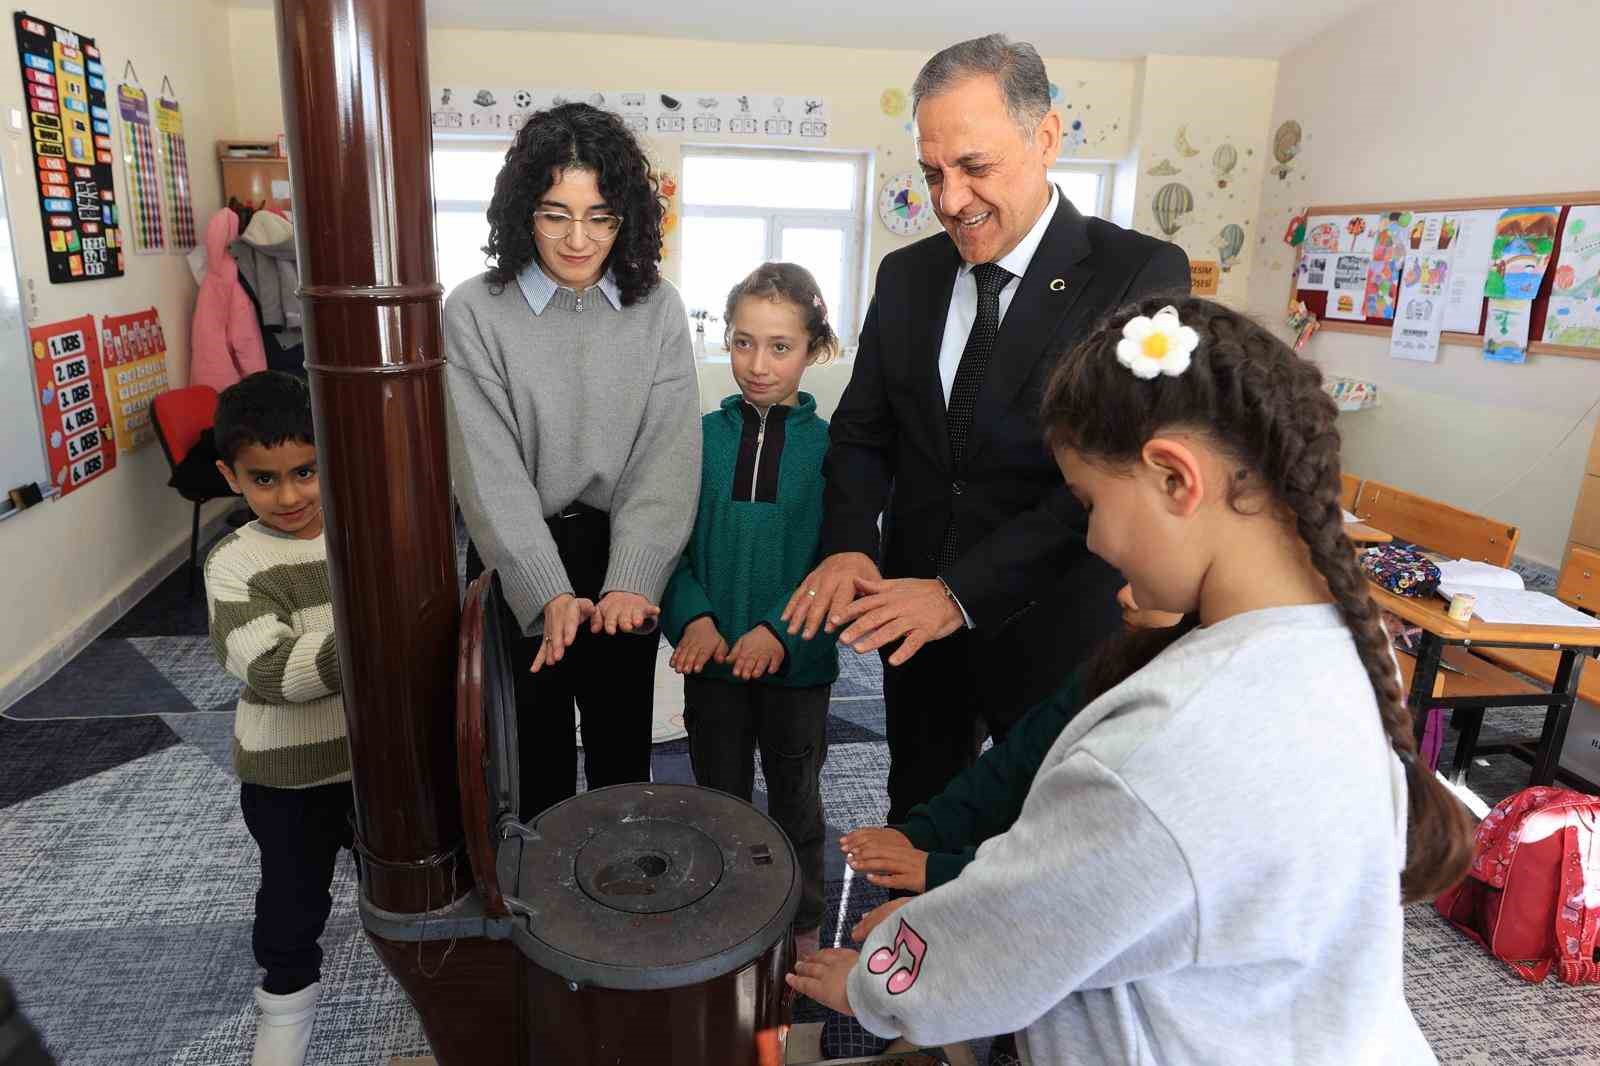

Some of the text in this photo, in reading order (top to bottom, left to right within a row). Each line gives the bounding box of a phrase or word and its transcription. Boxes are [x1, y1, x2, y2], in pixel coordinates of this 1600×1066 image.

[51, 334, 80, 356] 1. DERS
[56, 359, 86, 382] 2. DERS
[61, 384, 90, 408] 3. DERS
[65, 407, 95, 432] 4. DERS
[69, 431, 99, 457] 5. DERS
[73, 455, 102, 482] 6. DERS
